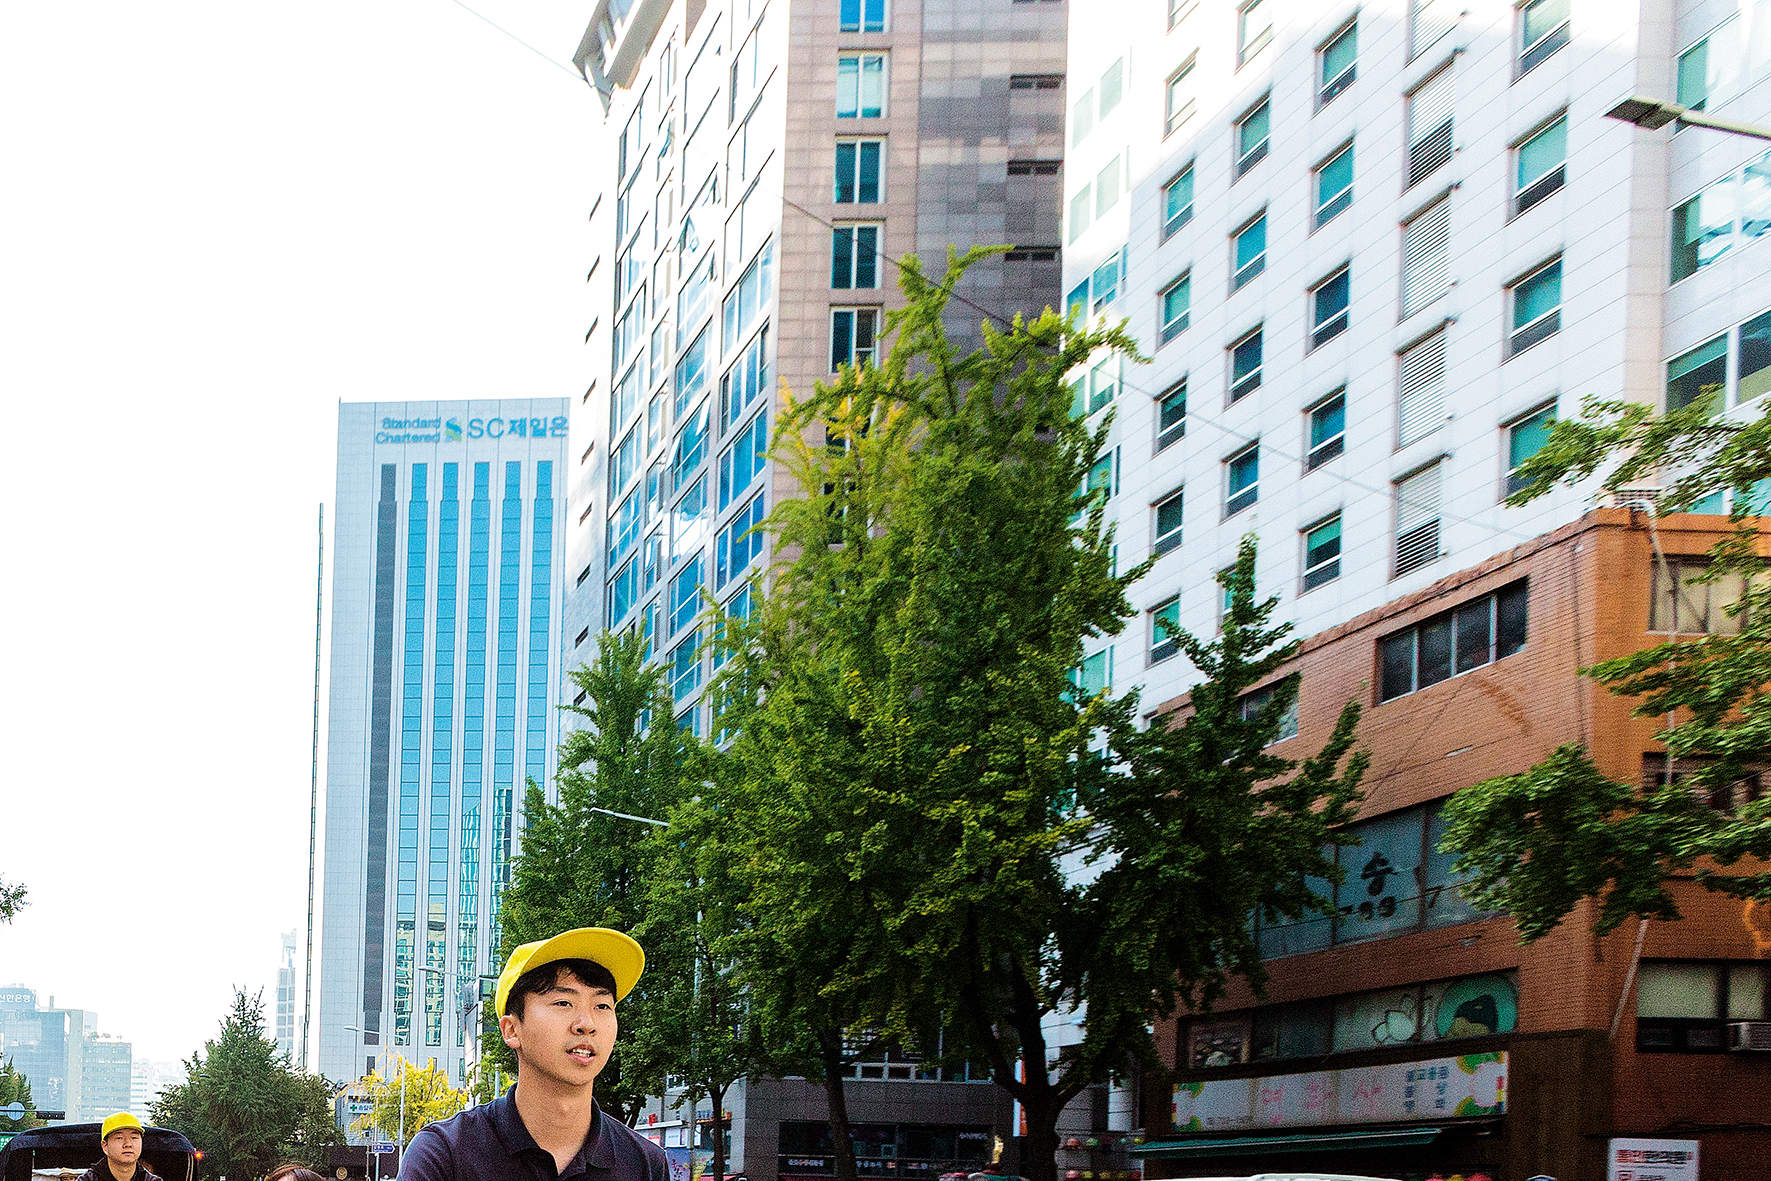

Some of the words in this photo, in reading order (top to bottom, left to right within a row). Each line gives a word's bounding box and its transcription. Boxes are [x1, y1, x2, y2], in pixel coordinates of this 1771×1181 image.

[381, 416, 442, 430] Standard
[468, 415, 569, 440] SC제일은
[375, 431, 441, 445] Chartered
